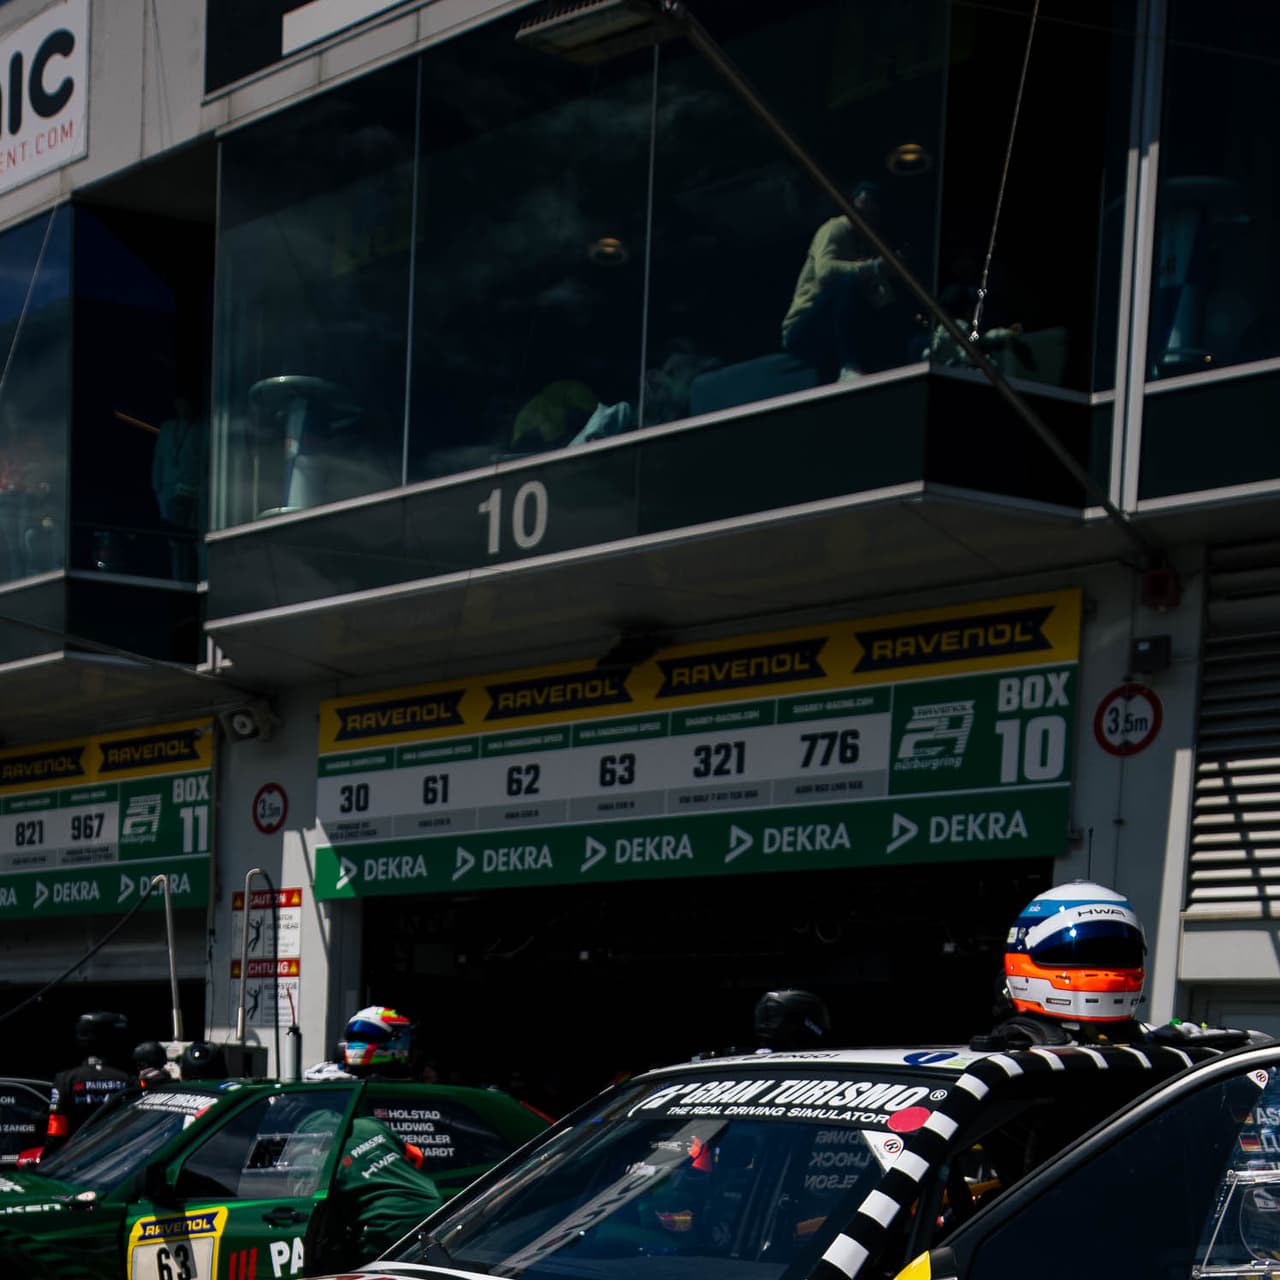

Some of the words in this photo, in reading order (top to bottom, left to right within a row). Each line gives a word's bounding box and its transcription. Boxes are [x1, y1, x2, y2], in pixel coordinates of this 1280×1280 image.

[478, 480, 548, 554] 10
[871, 621, 1033, 661] RAVENOL
[672, 650, 812, 688] RAVENOL
[498, 676, 619, 709] RAVENOL
[997, 670, 1071, 713] BOX
[346, 700, 455, 732] RAVENOL
[108, 738, 193, 768] RAVENOL
[693, 740, 746, 778] 321
[801, 730, 859, 768] 776
[994, 714, 1066, 783] 10
[3, 756, 80, 780] RAVENOL
[507, 764, 540, 796] 62
[600, 753, 635, 786] 63
[172, 775, 211, 804] BOX
[340, 783, 369, 813] 30
[423, 774, 449, 804] 61
[15, 820, 44, 846] 821
[72, 813, 105, 841] 967
[179, 804, 210, 854] 11
[762, 822, 852, 855] DEKRA
[928, 808, 1030, 844] DEKRA
[482, 844, 554, 873] DEKRA
[615, 834, 694, 865] DEKRA
[363, 854, 428, 882] DEKRA
[53, 880, 100, 904] DEKRA
[679, 1079, 773, 1105] GRAN
[774, 1079, 931, 1113] TURISMO
[388, 1109, 441, 1120] HOLSTAD
[390, 1121, 435, 1132] LUDWIG
[666, 1105, 689, 1116] THE
[689, 1105, 721, 1116] REAL
[722, 1106, 783, 1118] DRIVING
[786, 1107, 890, 1125] SIMULATOR
[145, 1218, 211, 1237] RAVENOL
